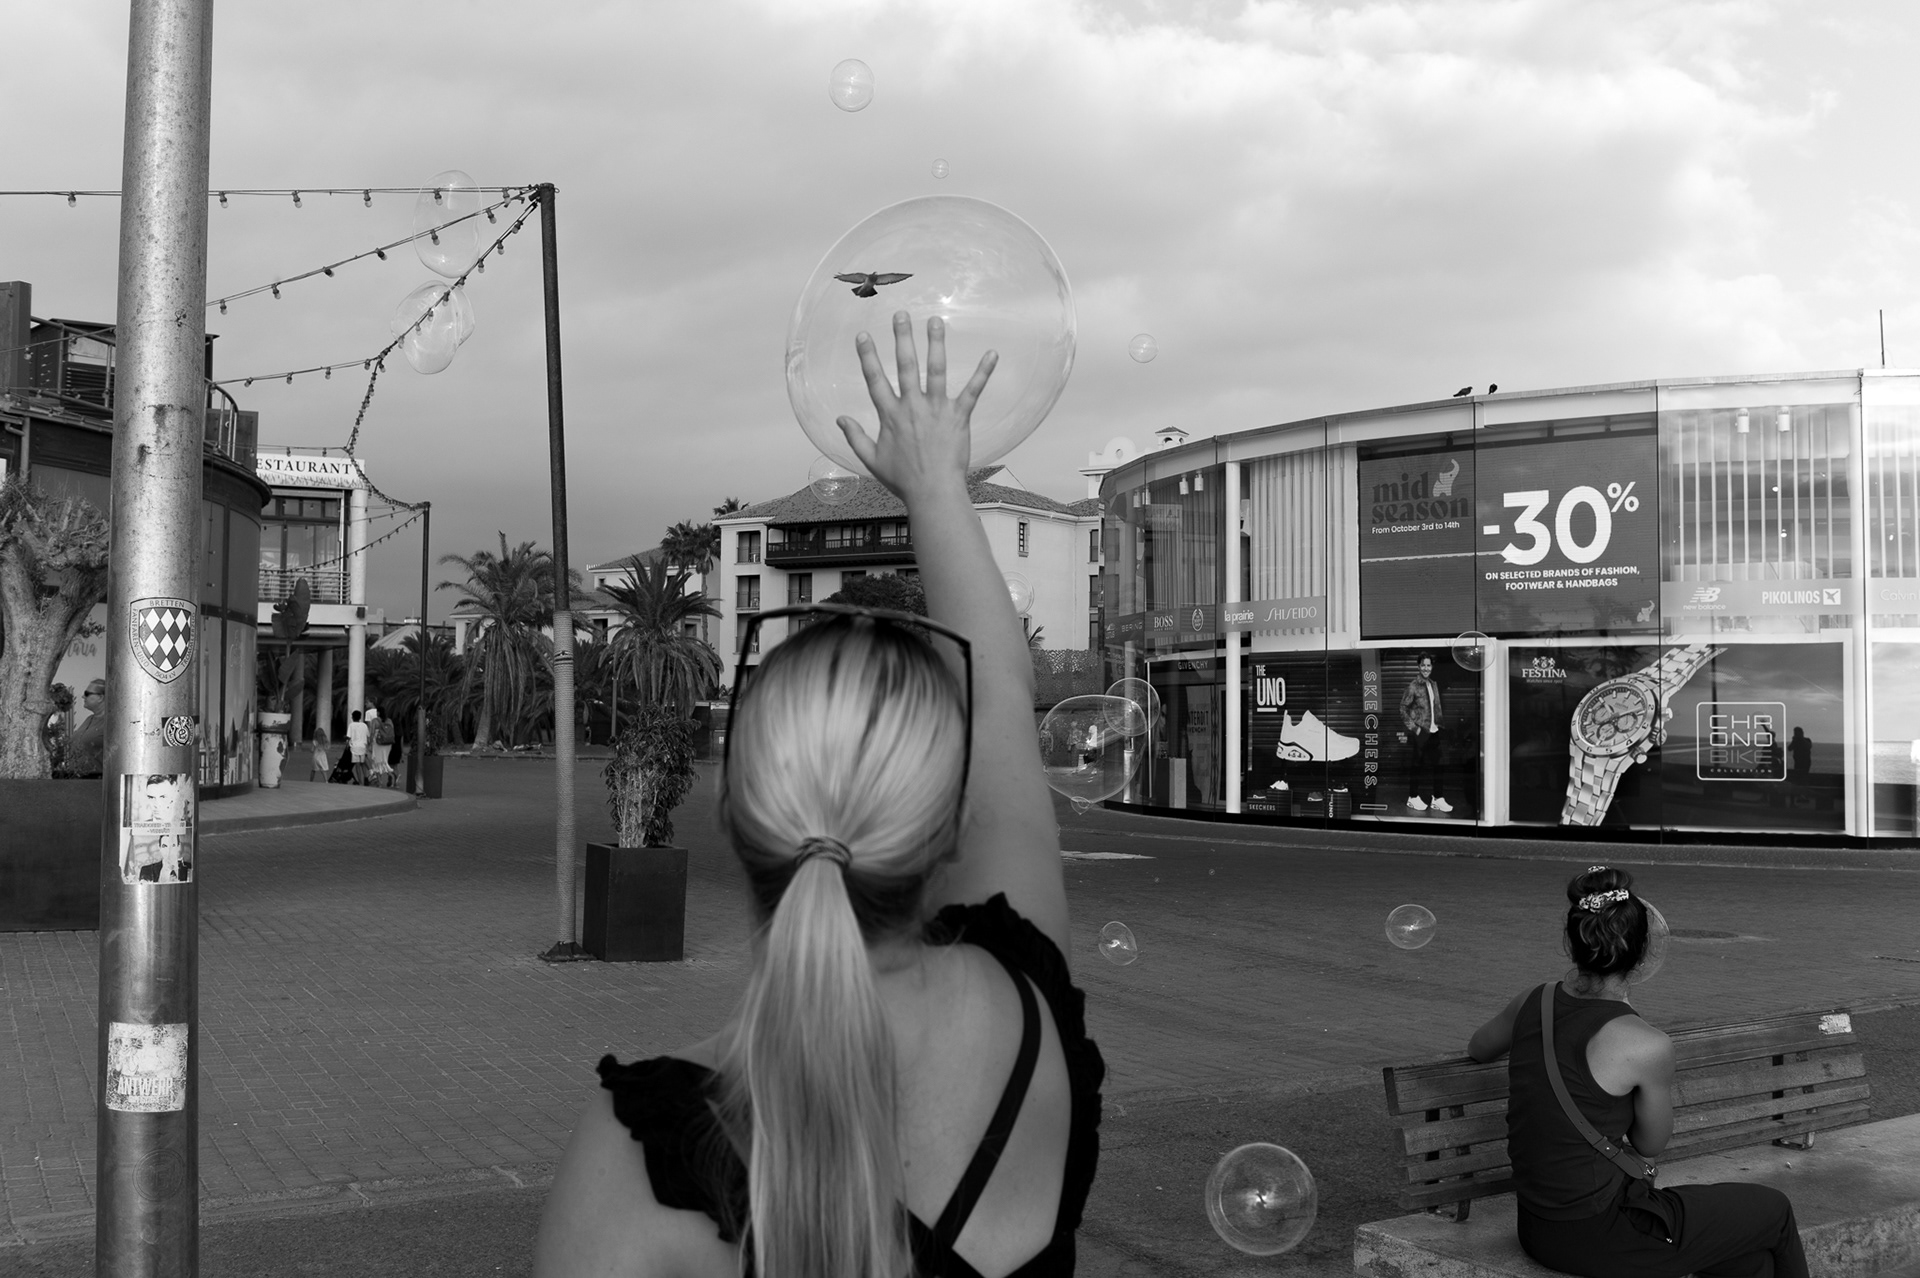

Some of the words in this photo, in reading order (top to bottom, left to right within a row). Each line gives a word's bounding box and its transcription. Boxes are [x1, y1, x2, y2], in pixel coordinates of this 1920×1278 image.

[256, 458, 352, 474] ESTAURANT
[1373, 472, 1429, 502] mid
[1372, 498, 1470, 524] season
[1391, 525, 1420, 533] October
[1486, 572, 1498, 580] ON
[1500, 570, 1542, 580] SELECTED
[1543, 568, 1580, 578] BRANDS
[1581, 568, 1594, 576] OF
[1595, 566, 1640, 575] FASHION,
[1506, 581, 1555, 590] FOOTWEAR
[1557, 580, 1564, 588] &
[1566, 578, 1618, 588] HANDBAGS
[1762, 590, 1820, 604] PIKOLINOS
[1880, 589, 1916, 601] Calvin
[150, 600, 185, 608] BRETTEN
[1224, 610, 1230, 622] la
[1232, 610, 1254, 625] prairie
[1264, 606, 1317, 622] SHISEIDO
[1154, 615, 1173, 628] BOSS
[1178, 660, 1208, 670] GIVENCHY
[1256, 665, 1266, 676] THE
[1521, 668, 1567, 678] FESTINA
[1257, 678, 1286, 706] UNO
[1364, 671, 1378, 786] SKECHERS
[1710, 715, 1773, 729] CHR
[1710, 732, 1773, 746] ONO
[1710, 750, 1772, 764] BIKE
[117, 1076, 173, 1095] ANTWERP
